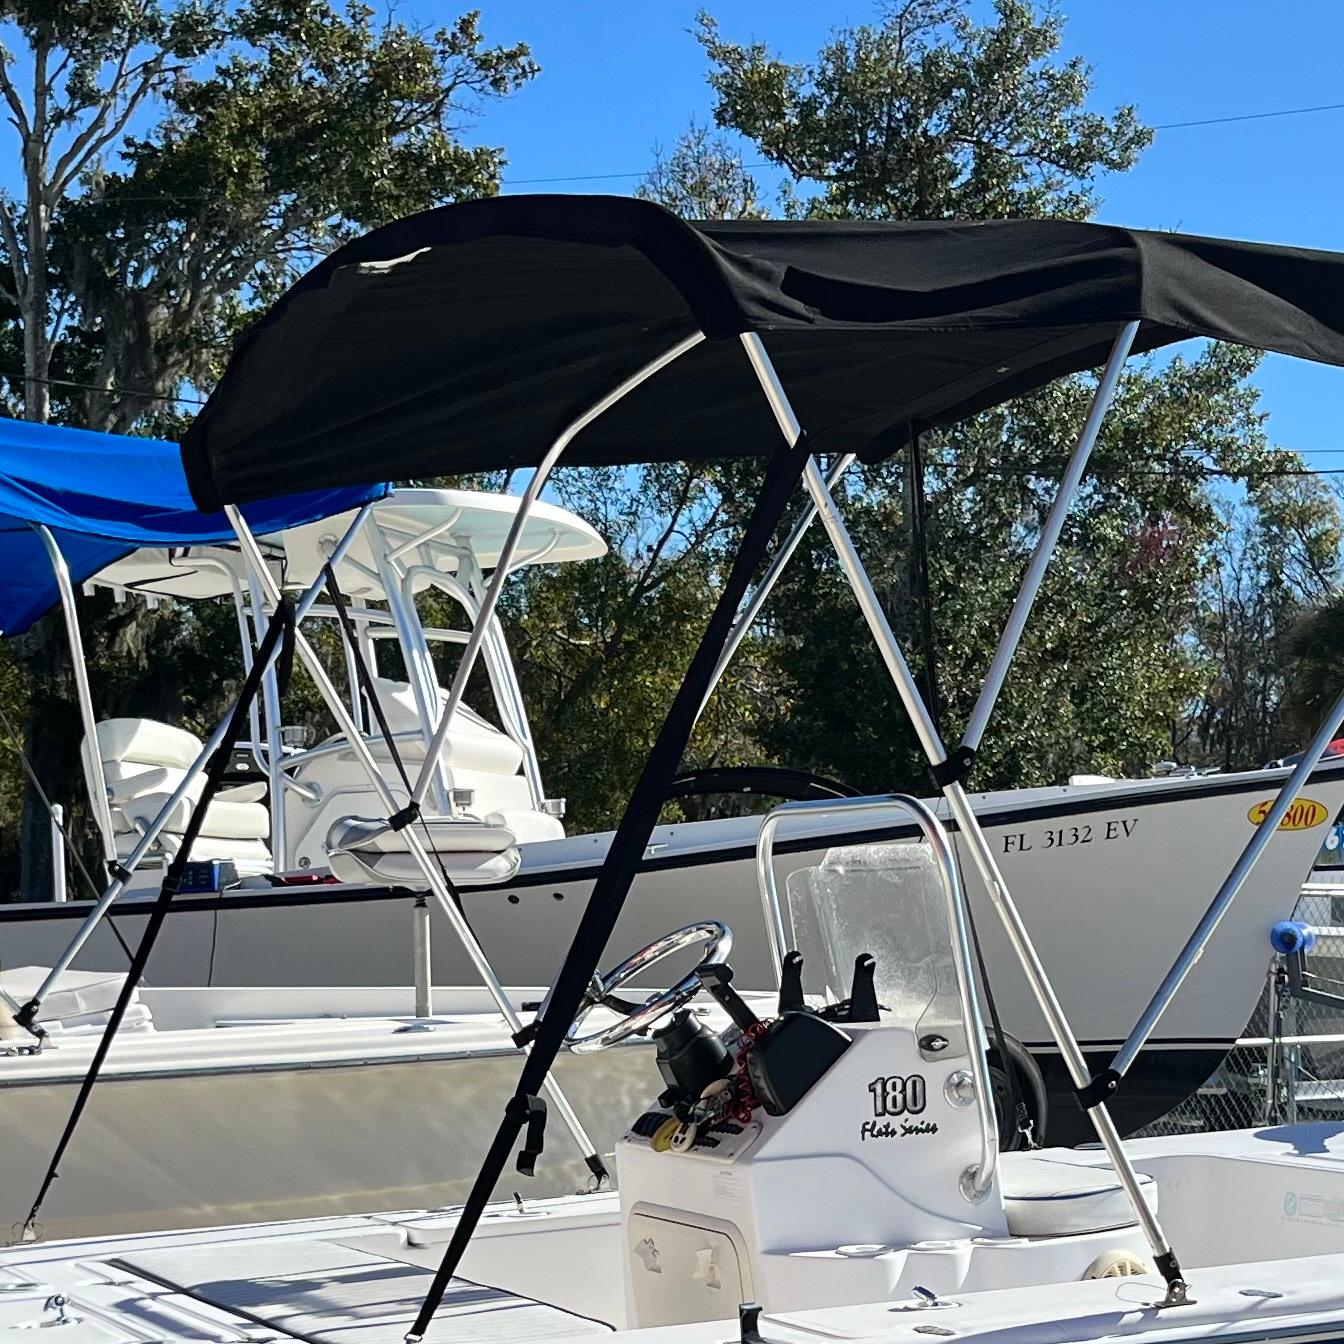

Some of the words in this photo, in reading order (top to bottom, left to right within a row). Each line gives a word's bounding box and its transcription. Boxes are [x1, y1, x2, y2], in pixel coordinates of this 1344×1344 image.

[1003, 834, 1032, 853] FL
[1042, 825, 1093, 849] 3132
[1105, 818, 1139, 840] EV
[868, 1074, 926, 1117] 180
